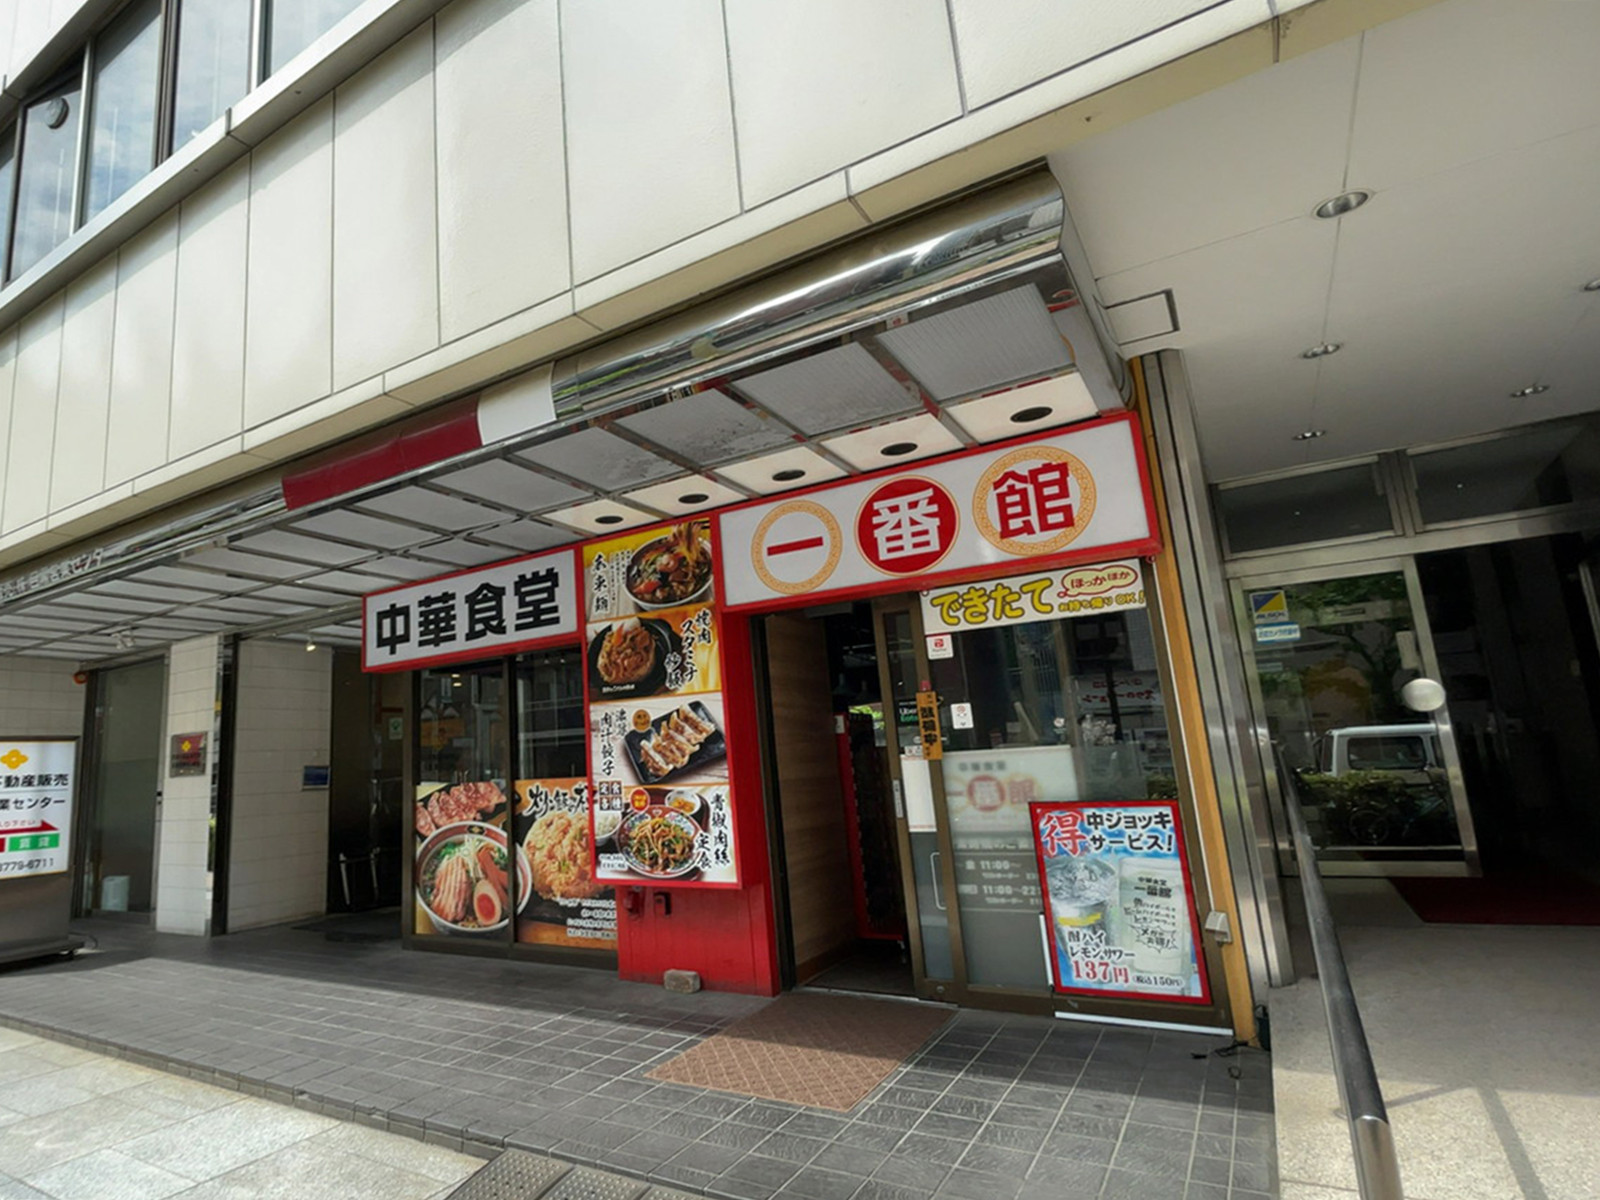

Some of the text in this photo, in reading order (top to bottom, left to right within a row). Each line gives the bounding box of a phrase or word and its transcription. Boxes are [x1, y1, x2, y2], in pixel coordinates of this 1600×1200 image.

[766, 461, 1076, 562] 一番館
[1071, 570, 1131, 588] ほっかほか
[376, 566, 561, 655] 中華食堂
[930, 578, 1054, 626] できたて
[682, 620, 698, 682] スタミナ
[0, 773, 69, 788] 動産販売
[1087, 811, 1172, 831] 中ジョッキ
[1042, 812, 1087, 857] 得
[1090, 834, 1173, 852] サービス!
[1069, 945, 1135, 961] レモンサワー
[1073, 960, 1130, 984] 137円
